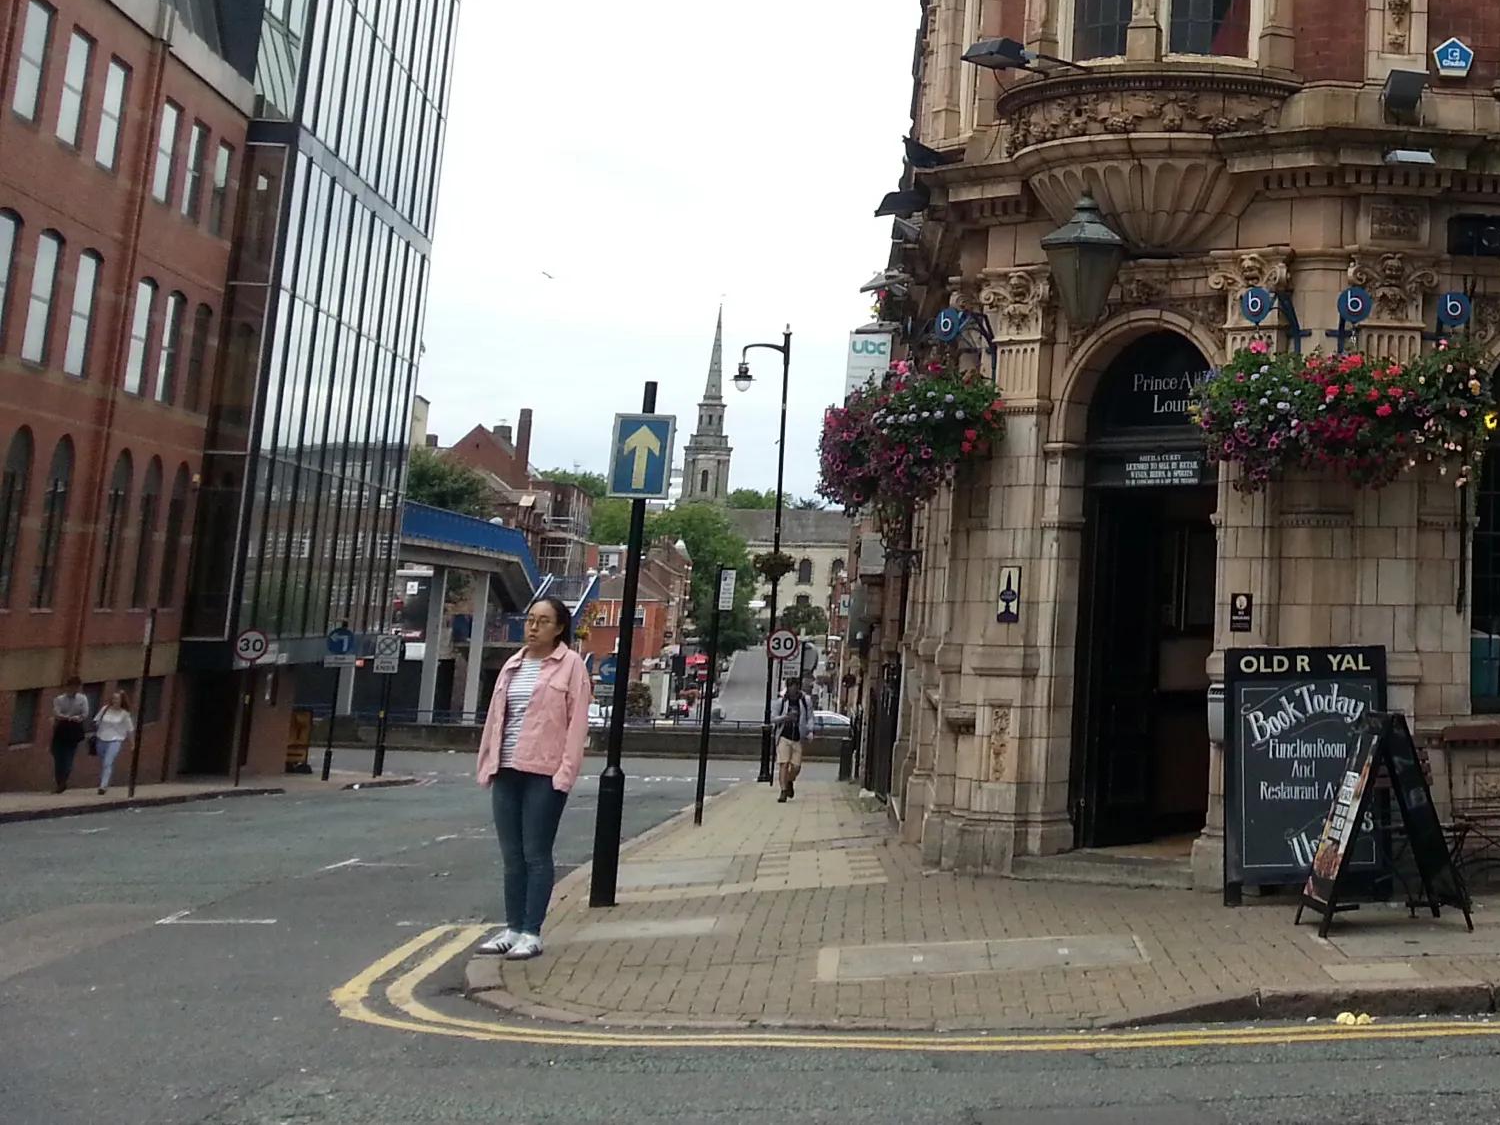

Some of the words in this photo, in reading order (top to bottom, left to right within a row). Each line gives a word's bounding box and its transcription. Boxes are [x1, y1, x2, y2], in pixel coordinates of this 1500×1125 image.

[1248, 286, 1262, 313] b
[1346, 289, 1362, 313] b
[1446, 294, 1462, 316] b
[1133, 373, 1178, 392] Prince
[239, 638, 264, 652] 30
[771, 637, 794, 651] 30
[1240, 655, 1290, 673] OLD
[1296, 654, 1371, 672] RYAL
[1246, 695, 1306, 747] Book
[1294, 683, 1365, 723] Today
[1268, 738, 1316, 759] Function
[1317, 738, 1347, 759] Room
[1291, 760, 1316, 778] And
[1260, 780, 1319, 800] Restaurant
